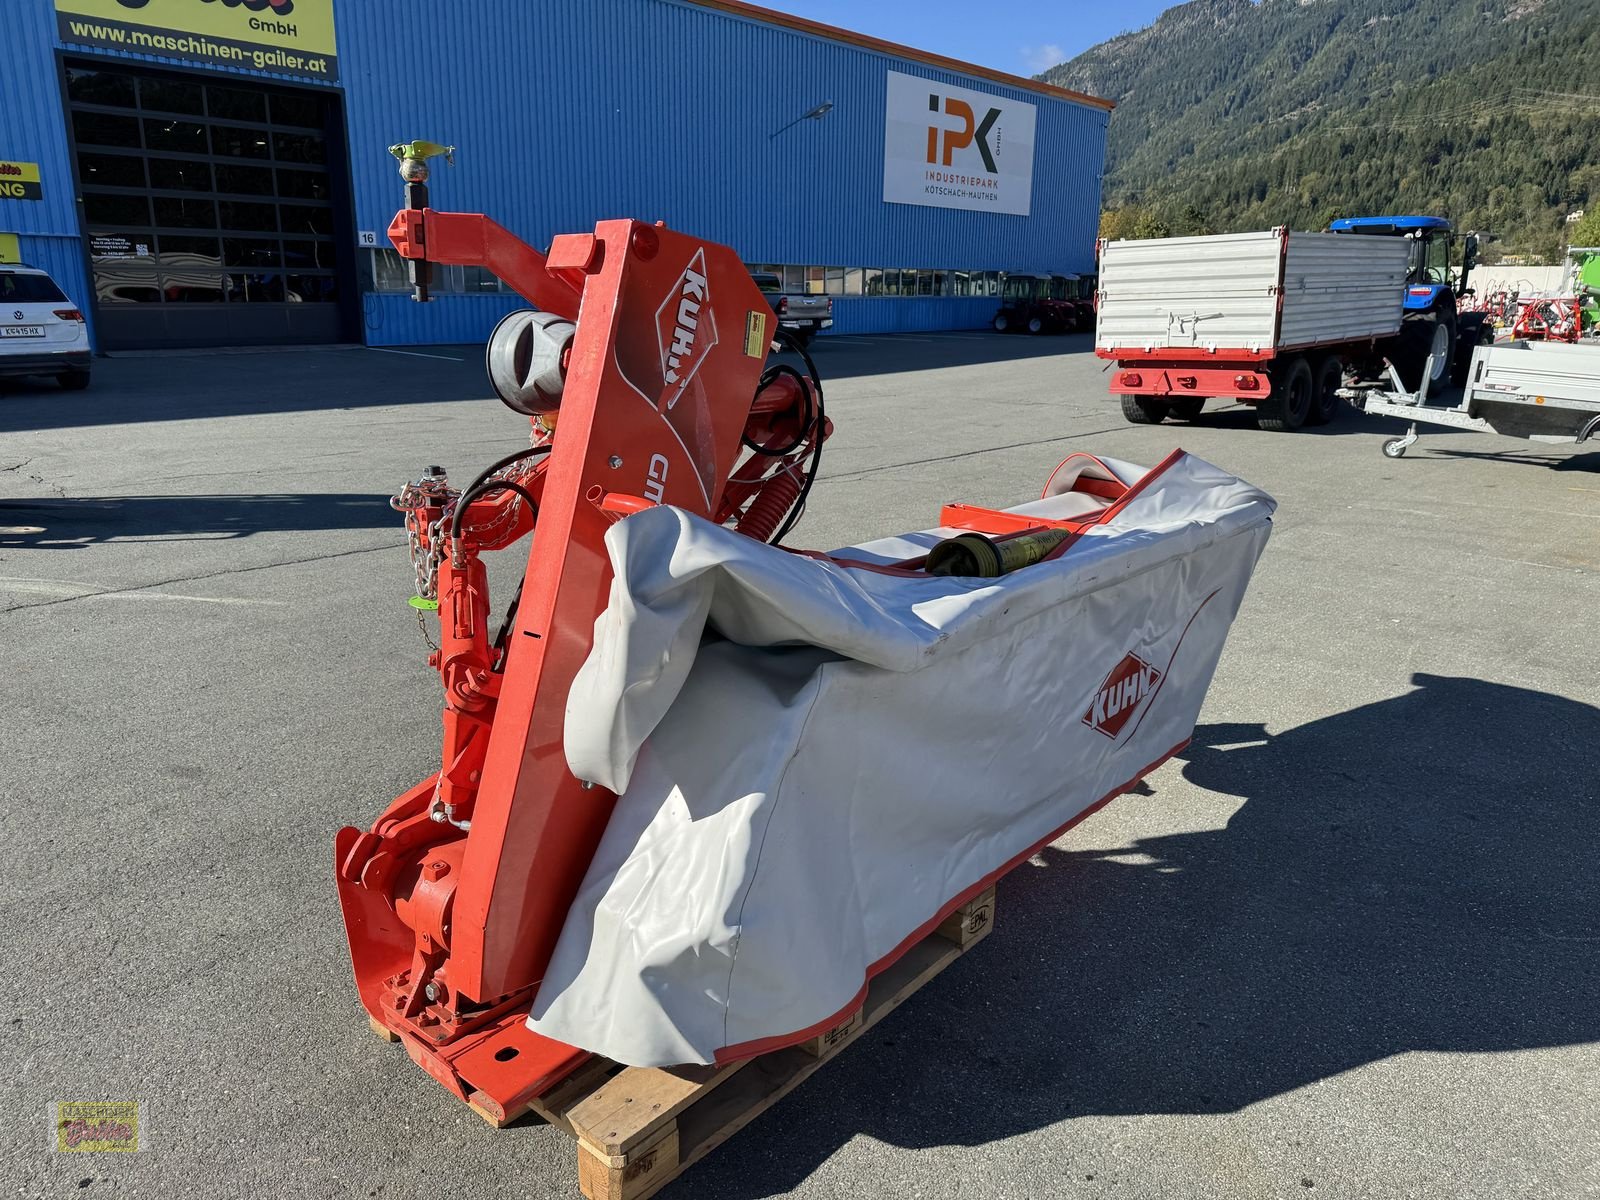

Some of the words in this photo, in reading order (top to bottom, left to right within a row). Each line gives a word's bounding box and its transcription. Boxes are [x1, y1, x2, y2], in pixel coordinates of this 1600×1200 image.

[248, 17, 297, 37] GmbH
[69, 20, 327, 73] www.maschinen-gailer.at
[925, 170, 998, 189] INDUSTRIEPARK
[361, 233, 374, 243] 16
[1090, 663, 1153, 730] KUHN
